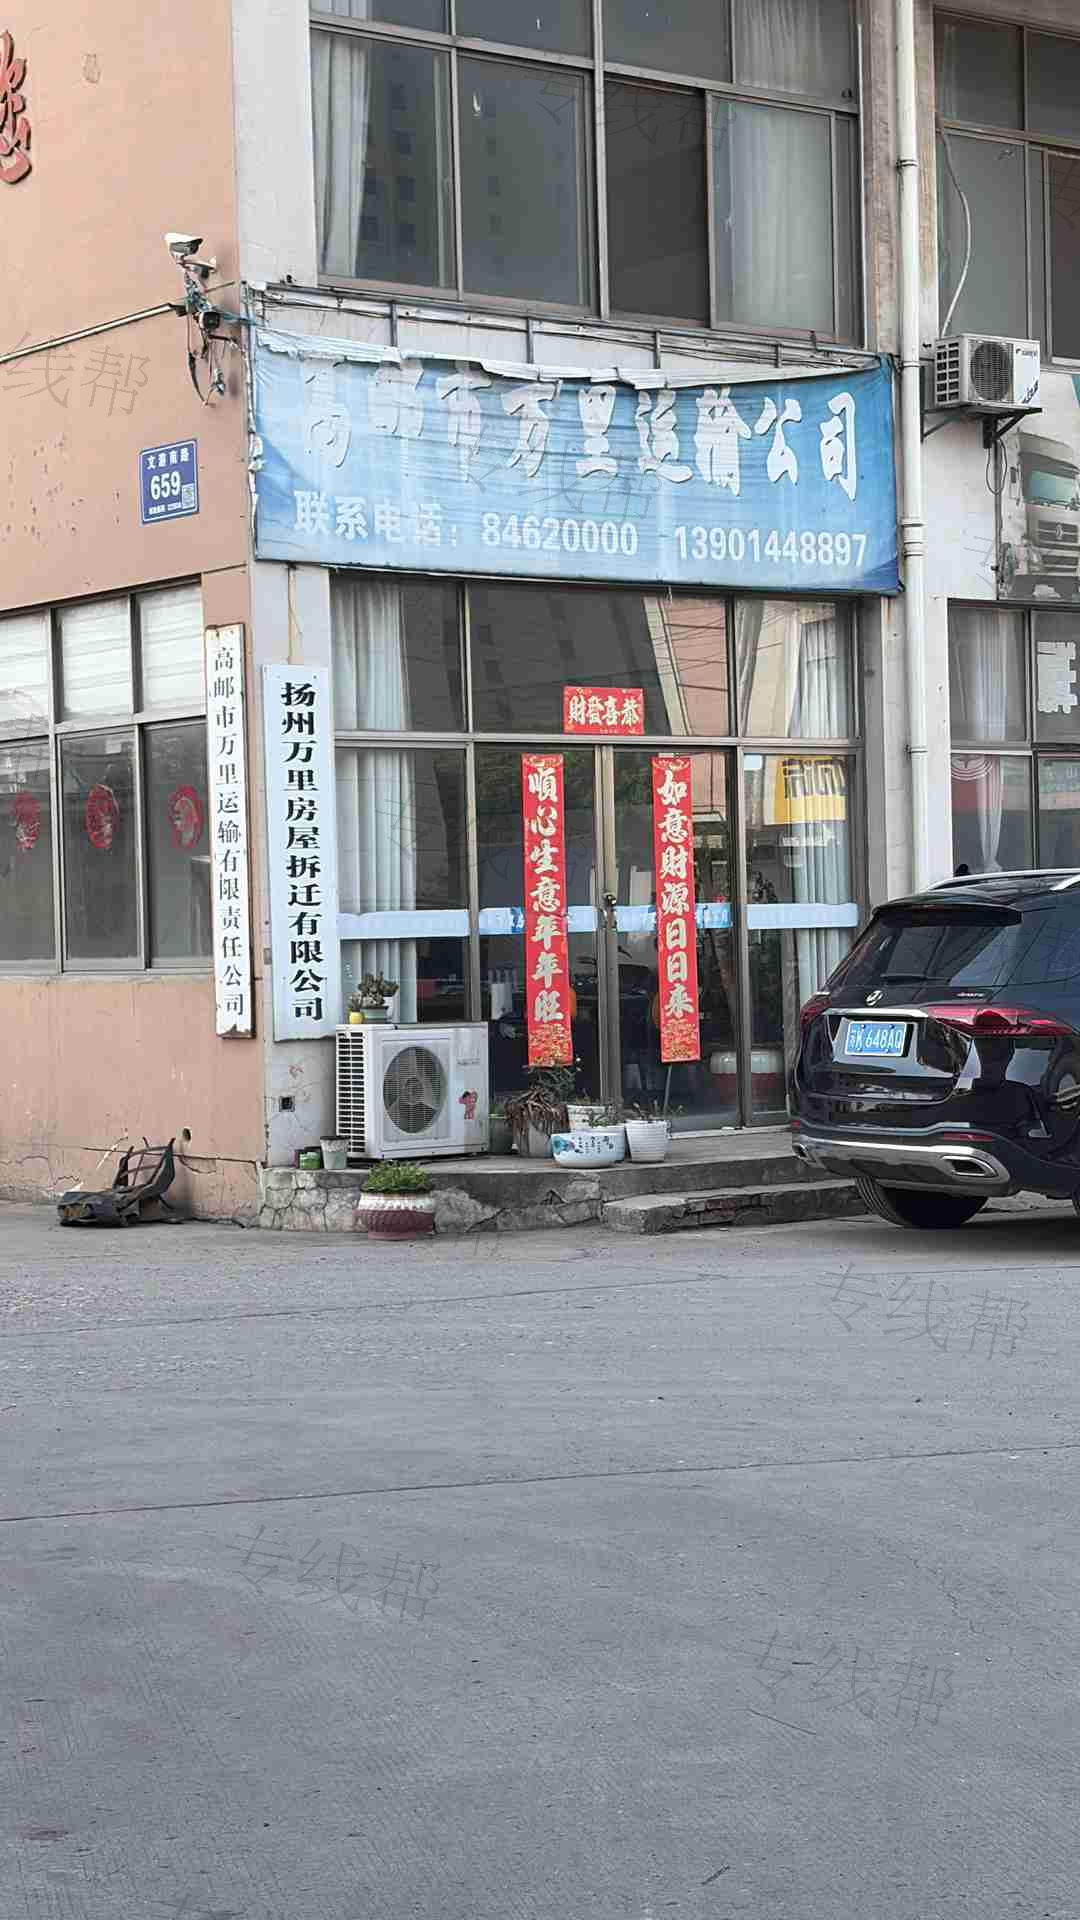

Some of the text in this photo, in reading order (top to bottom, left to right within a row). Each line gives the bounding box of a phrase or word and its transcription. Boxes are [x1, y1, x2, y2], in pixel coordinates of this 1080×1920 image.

[150, 470, 181, 500] 659
[481, 512, 639, 557] 84620000
[675, 525, 868, 567] 13901448897
[213, 646, 246, 1017] 高邮市万里运输有限责任公司
[280, 682, 325, 1022] 扬州万里房屋拆迁有限公司
